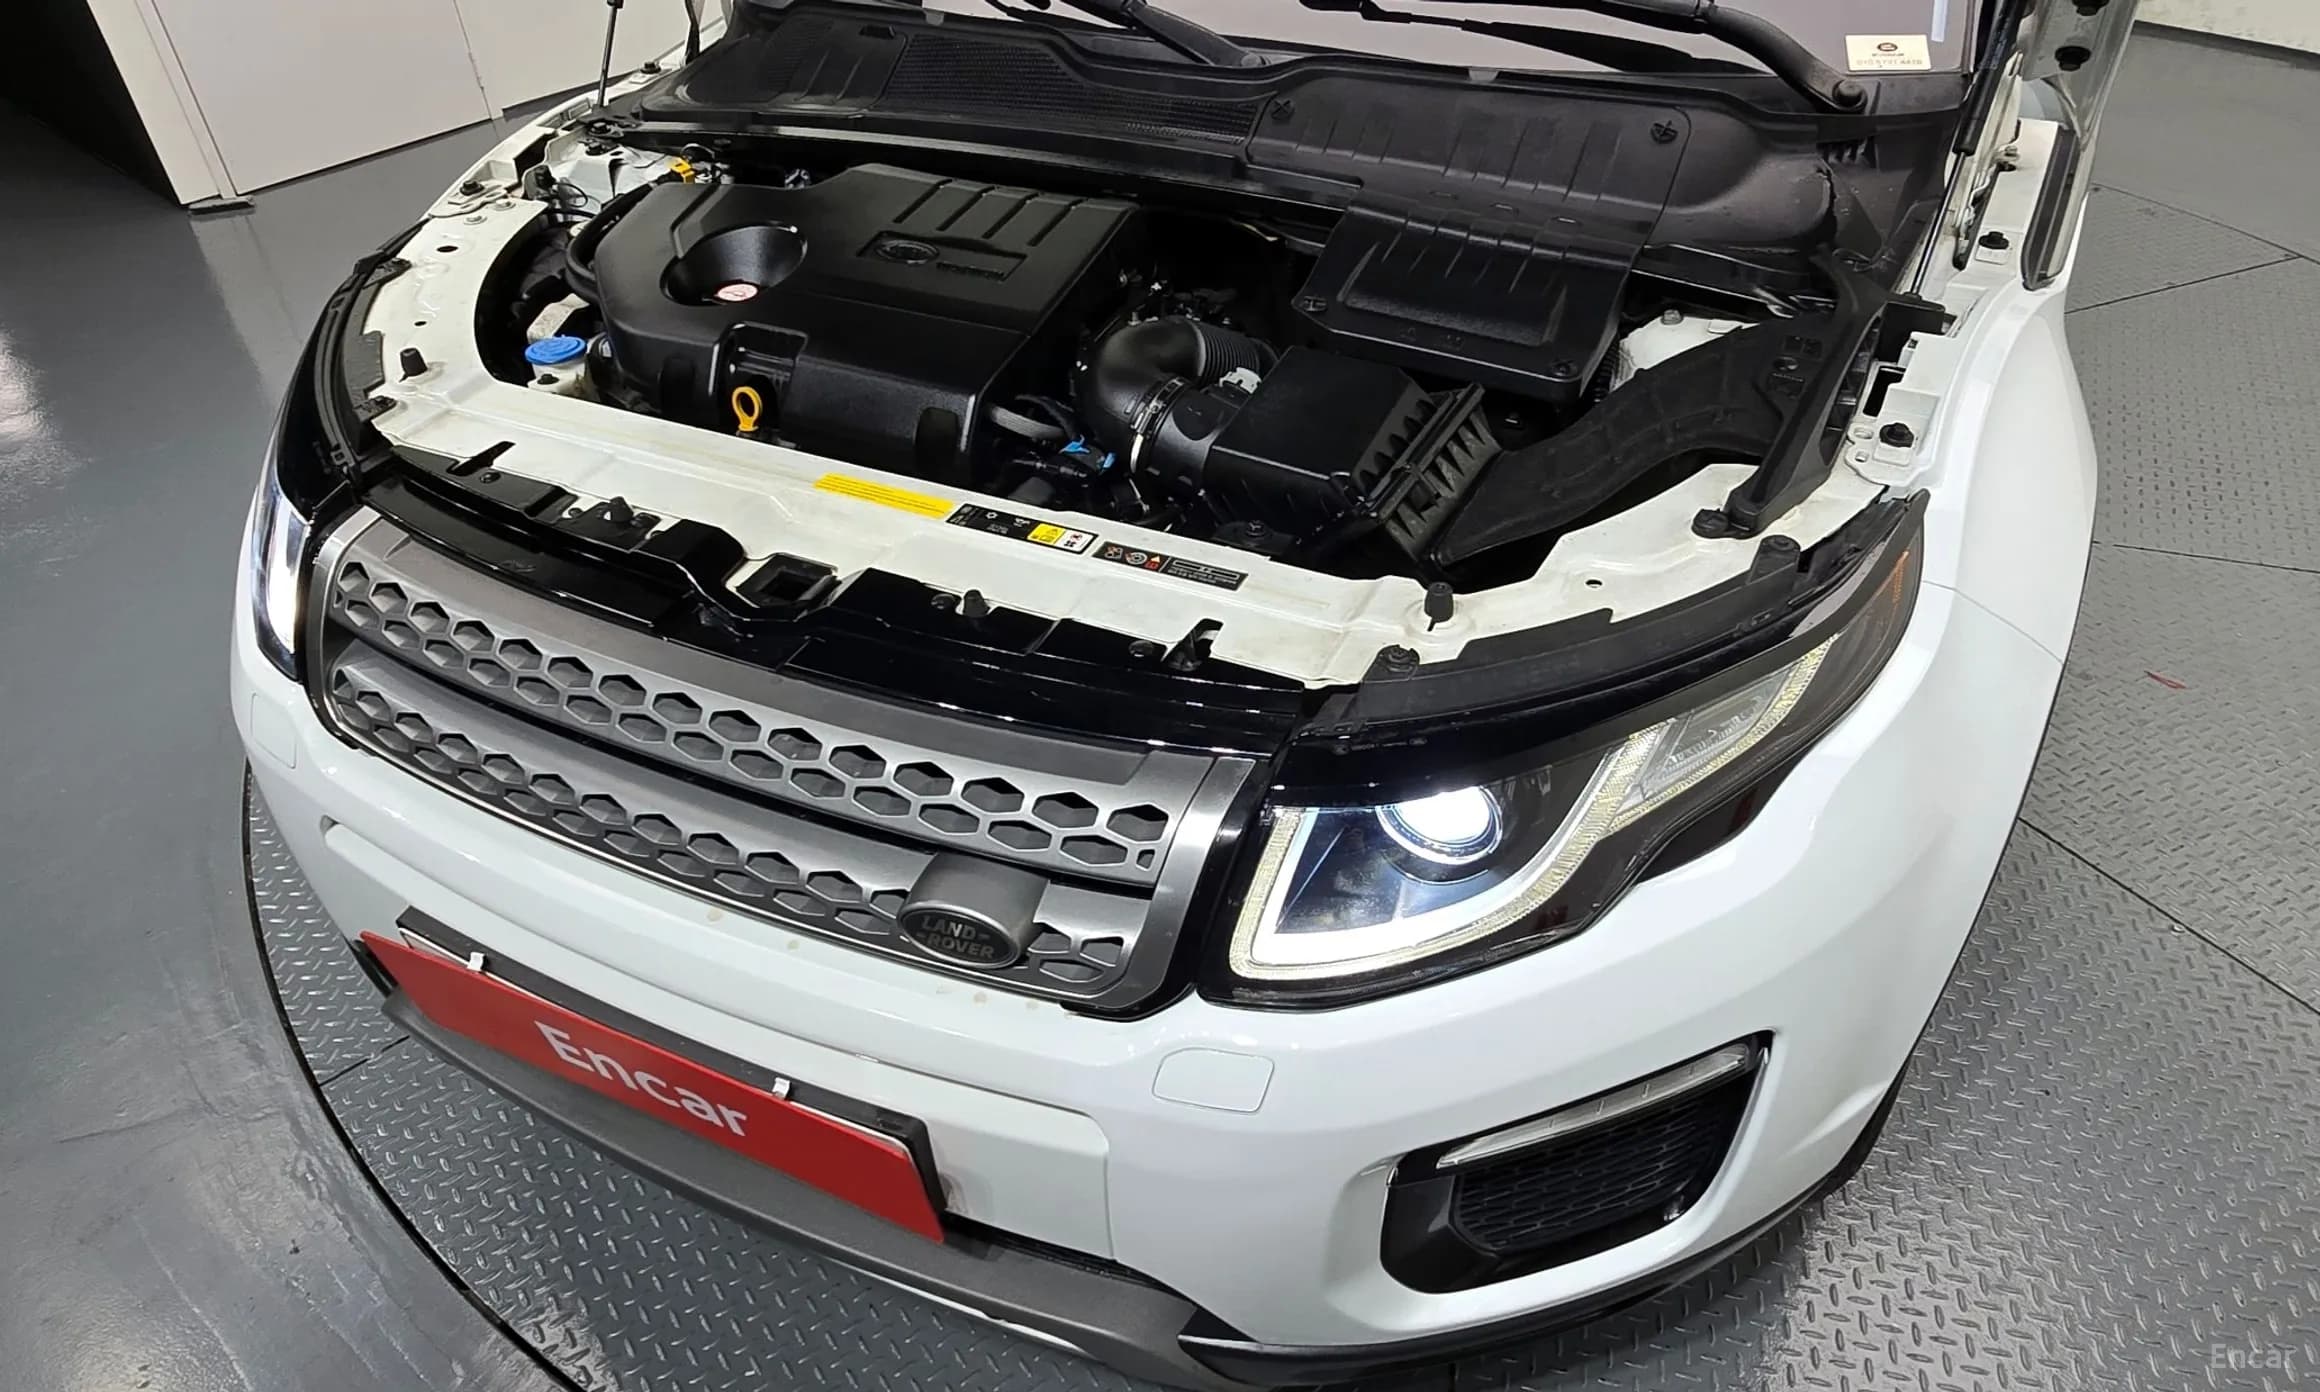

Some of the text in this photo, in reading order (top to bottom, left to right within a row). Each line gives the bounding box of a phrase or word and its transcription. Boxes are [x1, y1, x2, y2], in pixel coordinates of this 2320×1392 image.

[921, 916, 976, 939] LAND
[928, 934, 994, 959] ROVER
[534, 1020, 748, 1137] Encar
